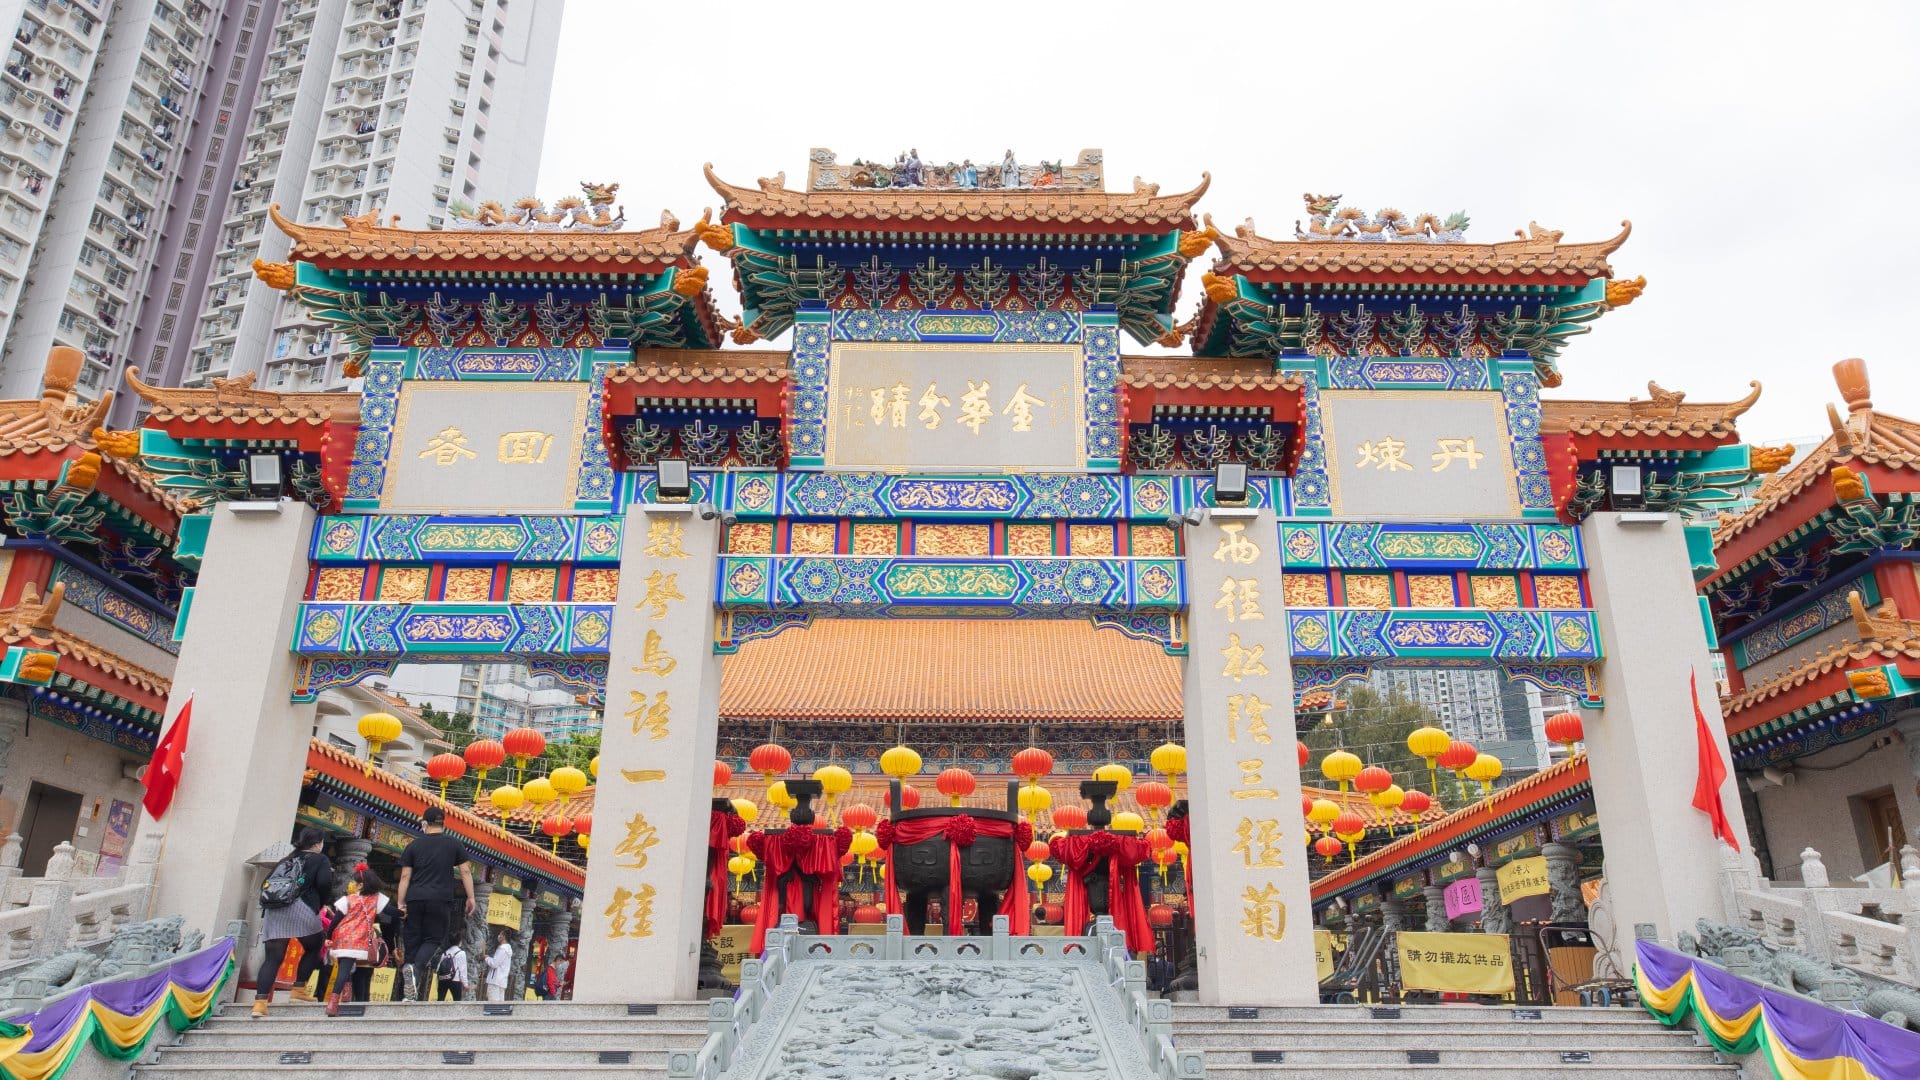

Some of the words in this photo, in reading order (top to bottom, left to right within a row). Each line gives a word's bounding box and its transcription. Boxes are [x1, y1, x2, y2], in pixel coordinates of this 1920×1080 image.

[1406, 949, 1504, 967] 請勿擺放供品
